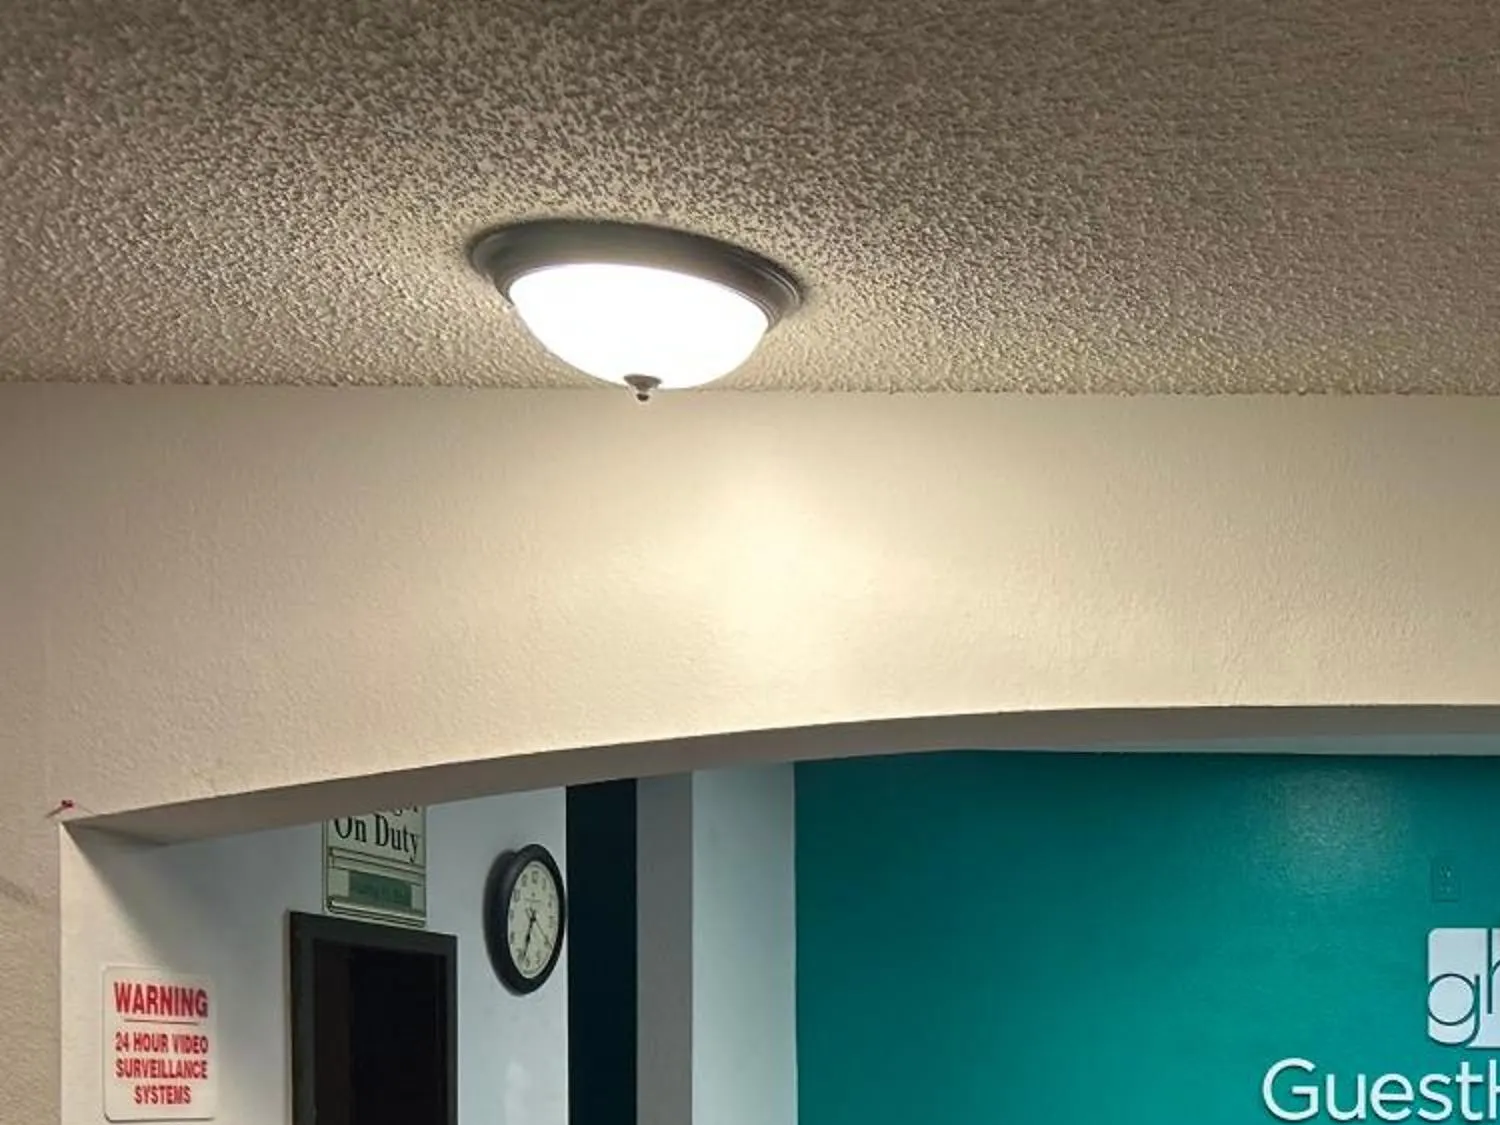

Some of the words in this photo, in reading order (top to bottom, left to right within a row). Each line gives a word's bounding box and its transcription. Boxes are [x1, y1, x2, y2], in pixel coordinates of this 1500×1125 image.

[335, 816, 366, 842] On
[374, 813, 418, 863] Duty
[114, 982, 208, 1017] WARNING
[115, 1031, 129, 1052] 24
[133, 1032, 169, 1053] HOUR
[172, 1034, 209, 1054] VIDEO
[115, 1058, 208, 1079] SURVEILLANCE
[134, 1085, 192, 1104] SYSTEMS
